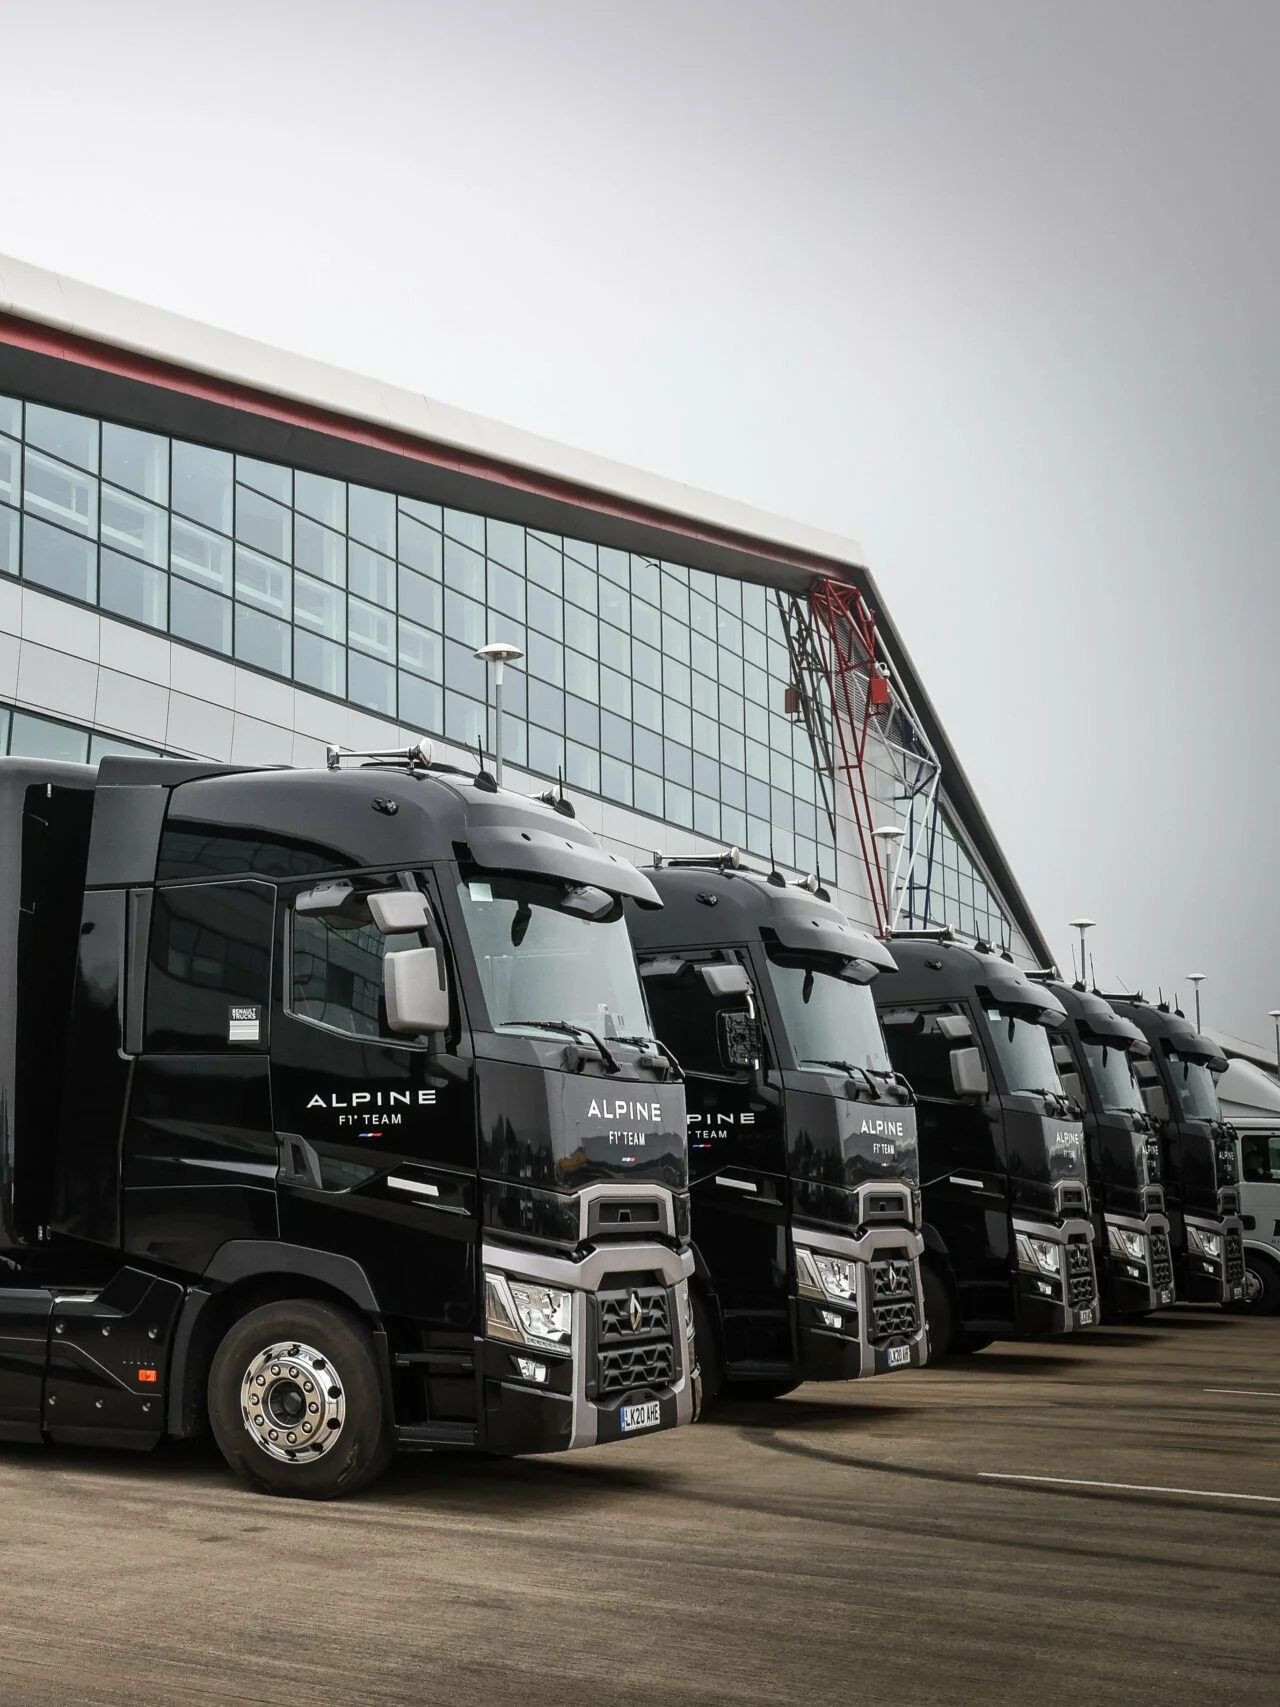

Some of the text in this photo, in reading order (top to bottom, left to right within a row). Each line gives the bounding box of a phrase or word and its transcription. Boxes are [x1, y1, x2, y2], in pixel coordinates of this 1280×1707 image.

[306, 1089, 437, 1109] ALPINE
[587, 1098, 661, 1122] ALPINE
[363, 1113, 402, 1125] TEAM
[686, 1112, 755, 1125] PINE
[695, 1129, 727, 1139] TEAM
[861, 1119, 903, 1136] ALPINE
[623, 1132, 646, 1145] TEAM
[1056, 1131, 1079, 1145] ALPINE
[625, 1403, 659, 1427] LK20 AHE
